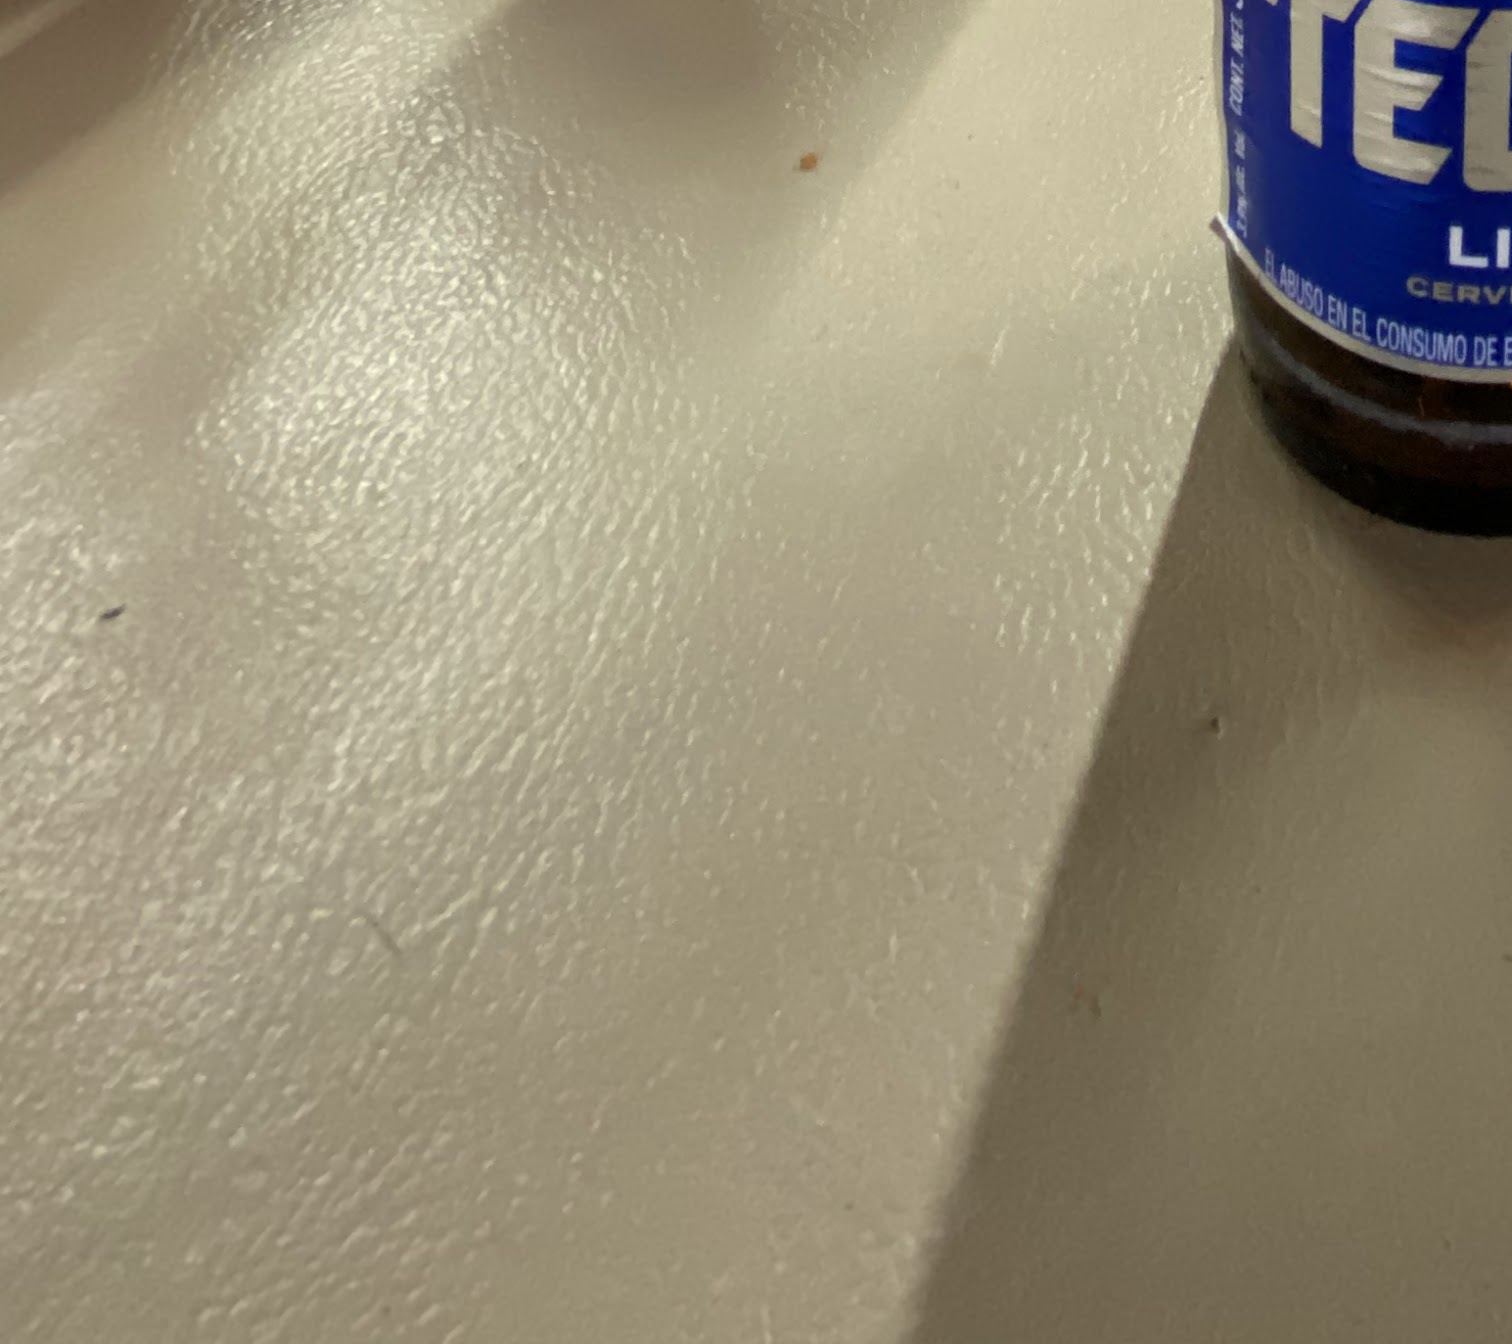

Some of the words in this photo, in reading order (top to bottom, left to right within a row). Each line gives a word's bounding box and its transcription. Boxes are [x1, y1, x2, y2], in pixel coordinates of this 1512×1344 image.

[1279, 263, 1324, 318] ABUSO
[1328, 294, 1347, 332] EN
[1352, 307, 1372, 342] EL
[1376, 318, 1467, 365] CONSUMO
[1474, 335, 1498, 367] DE
